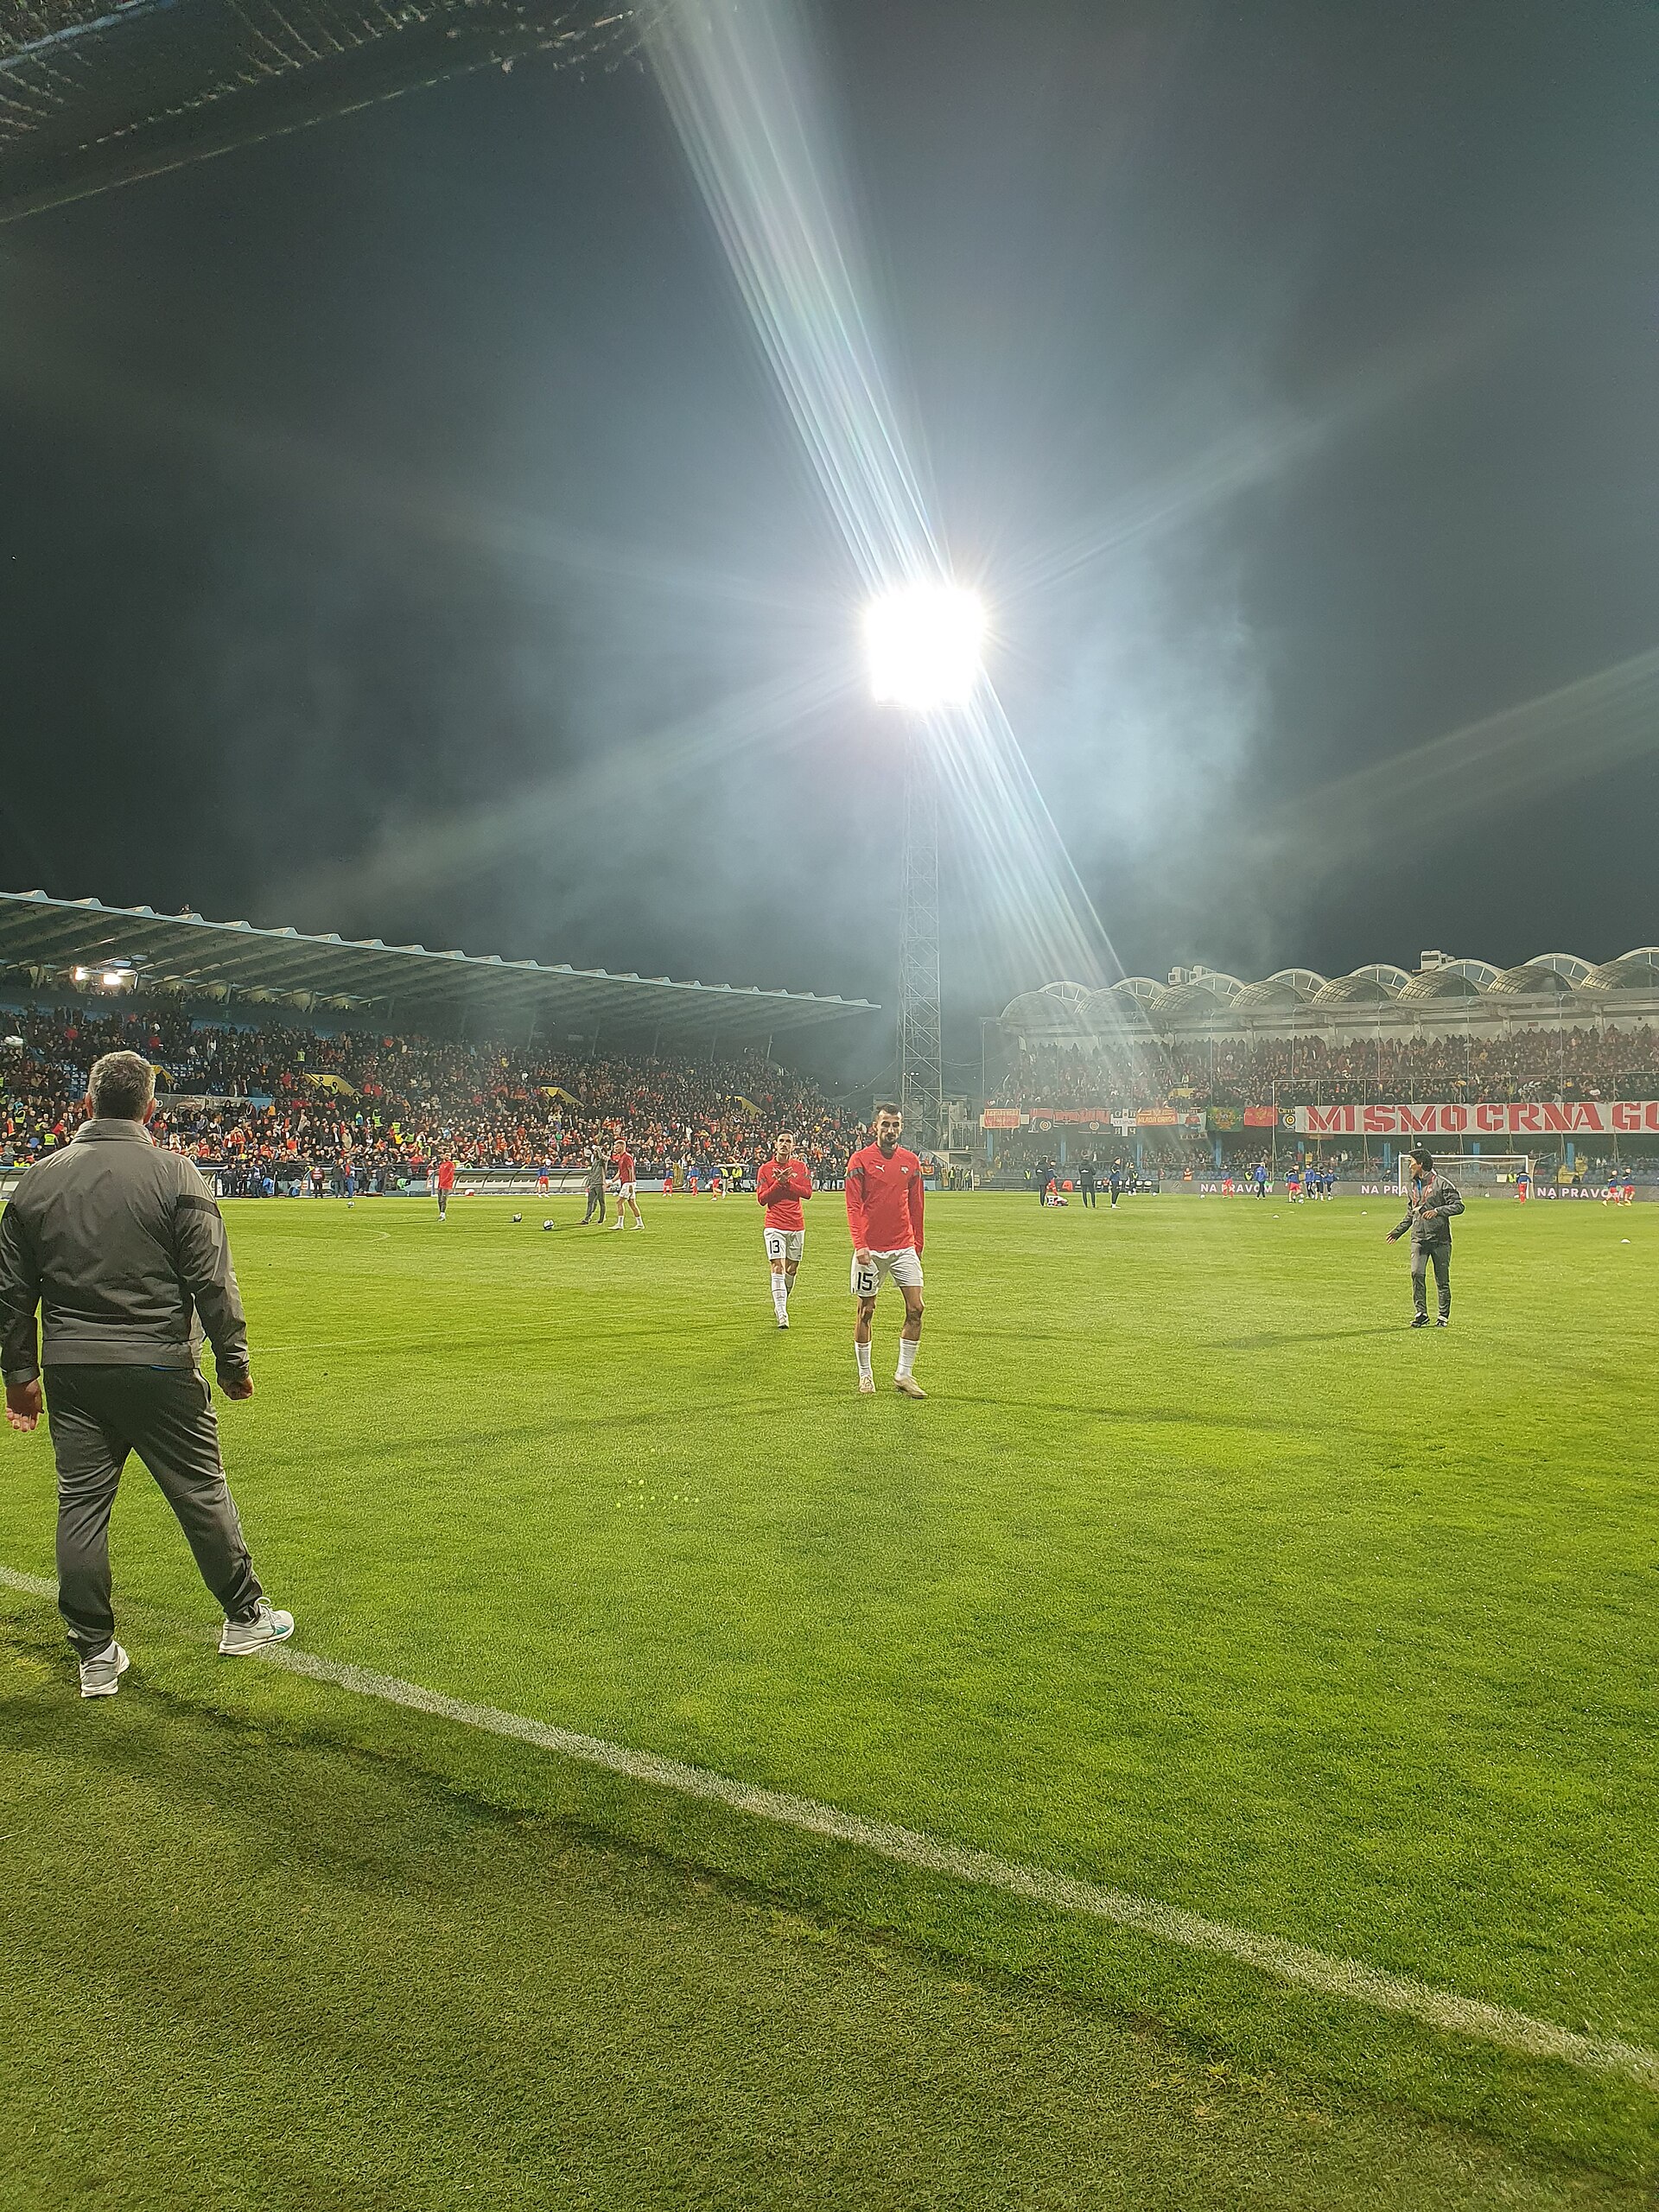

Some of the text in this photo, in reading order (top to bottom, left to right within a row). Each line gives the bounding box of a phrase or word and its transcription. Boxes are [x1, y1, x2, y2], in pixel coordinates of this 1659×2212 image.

[1306, 1105, 1356, 1132] MI
[1363, 1104, 1467, 1132] SMO
[1477, 1103, 1605, 1131] CRNA
[1200, 1183, 1217, 1192] NA
[1361, 1185, 1379, 1194] NA
[1537, 1187, 1557, 1197] NA
[769, 1240, 780, 1254] 13
[857, 1271, 874, 1291] 15
